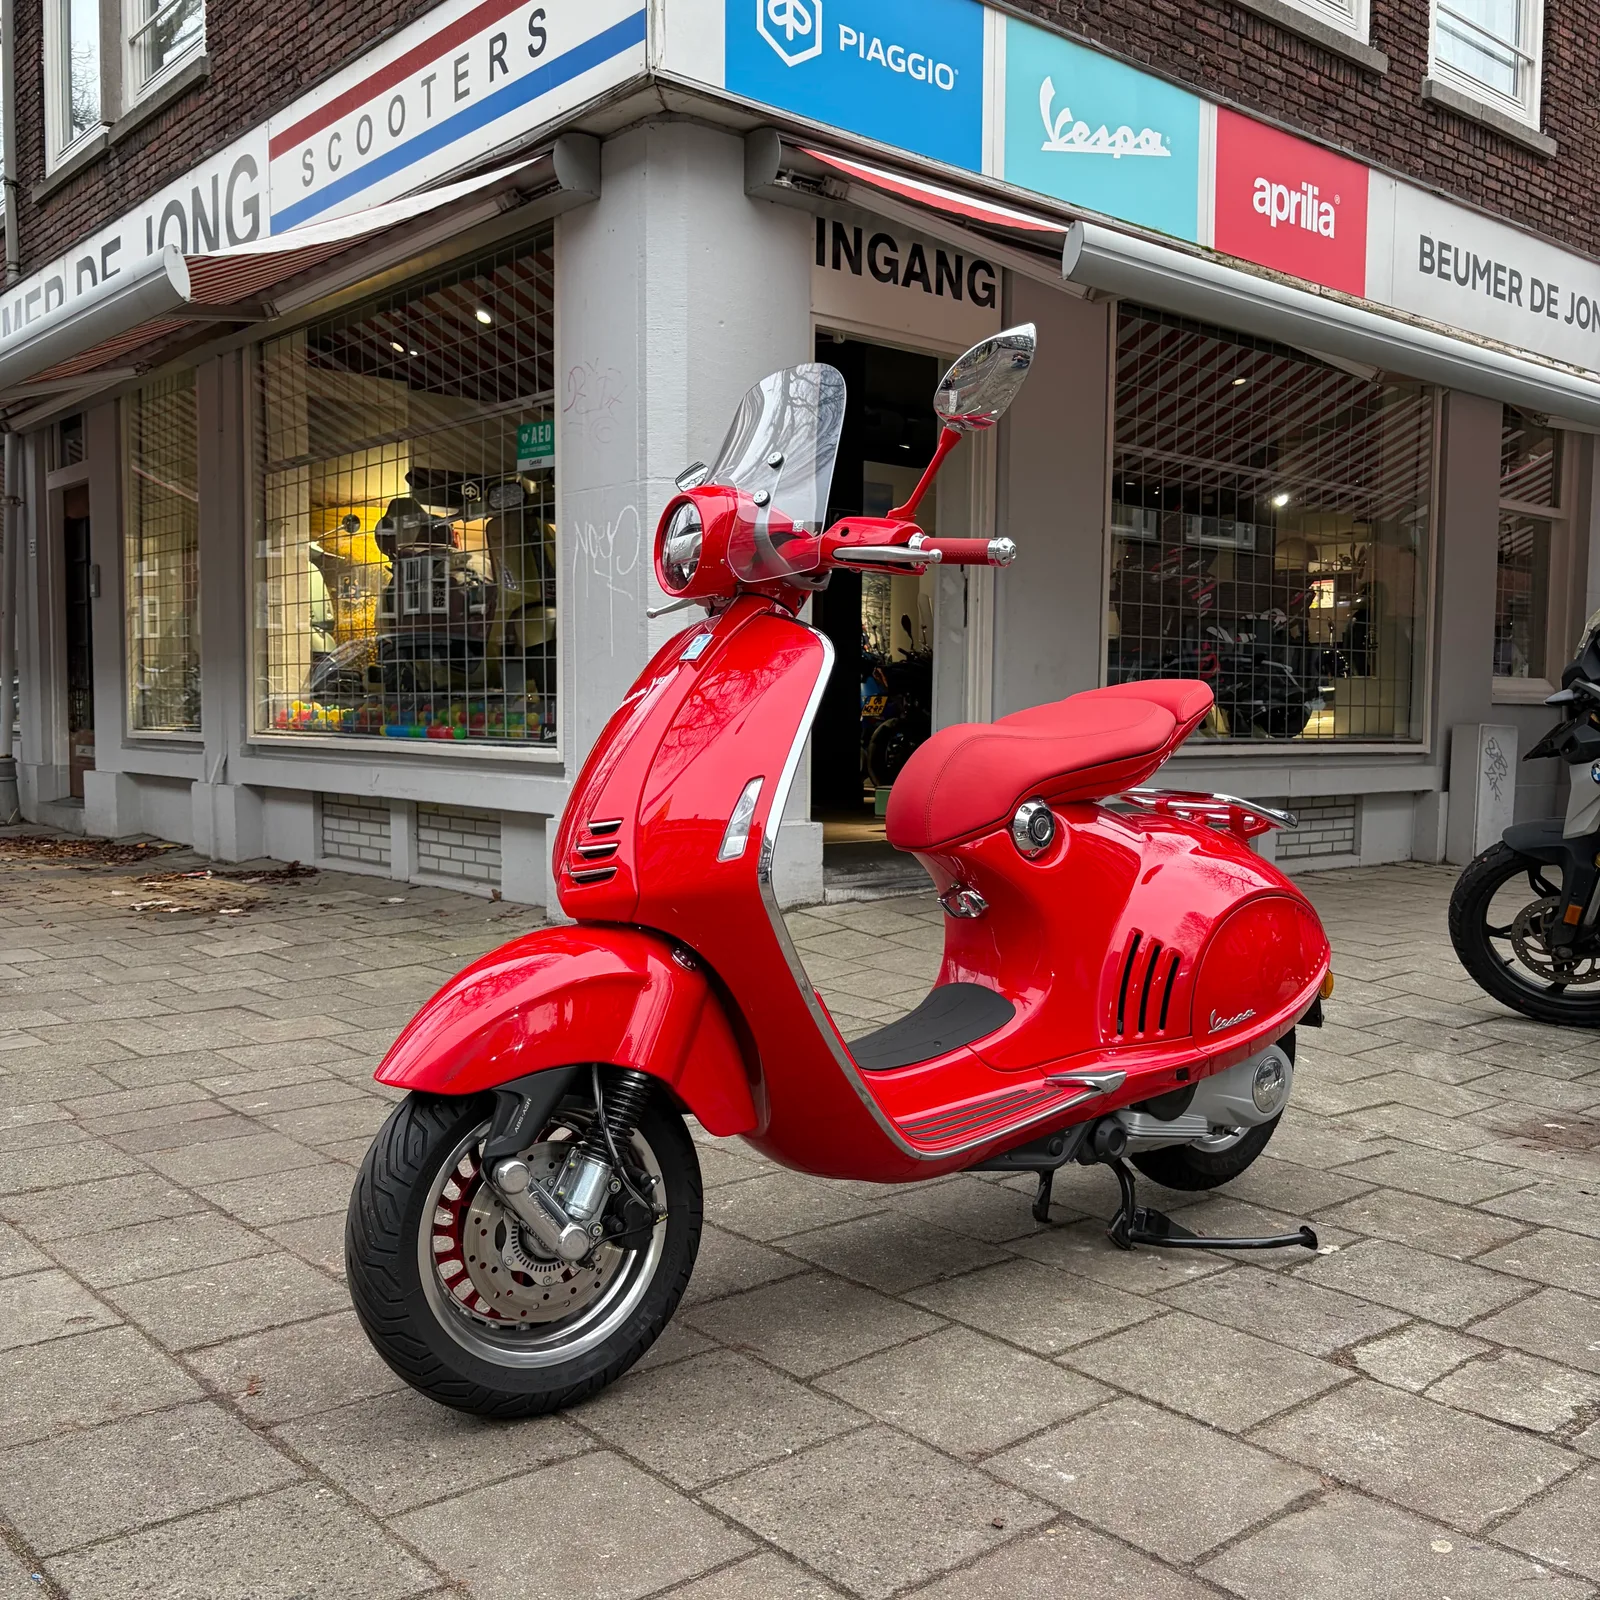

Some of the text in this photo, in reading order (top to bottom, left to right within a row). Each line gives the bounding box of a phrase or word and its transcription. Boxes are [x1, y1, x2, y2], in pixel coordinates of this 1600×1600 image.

[301, 7, 547, 188] SCOOTERS
[838, 23, 954, 91] PIAGGIO
[1039, 75, 1171, 159] Vespa
[1252, 176, 1335, 239] aprilia
[815, 216, 996, 309] INGANG
[1418, 234, 1523, 308] BEUMER
[1529, 277, 1559, 320] DE
[531, 424, 551, 444] AED
